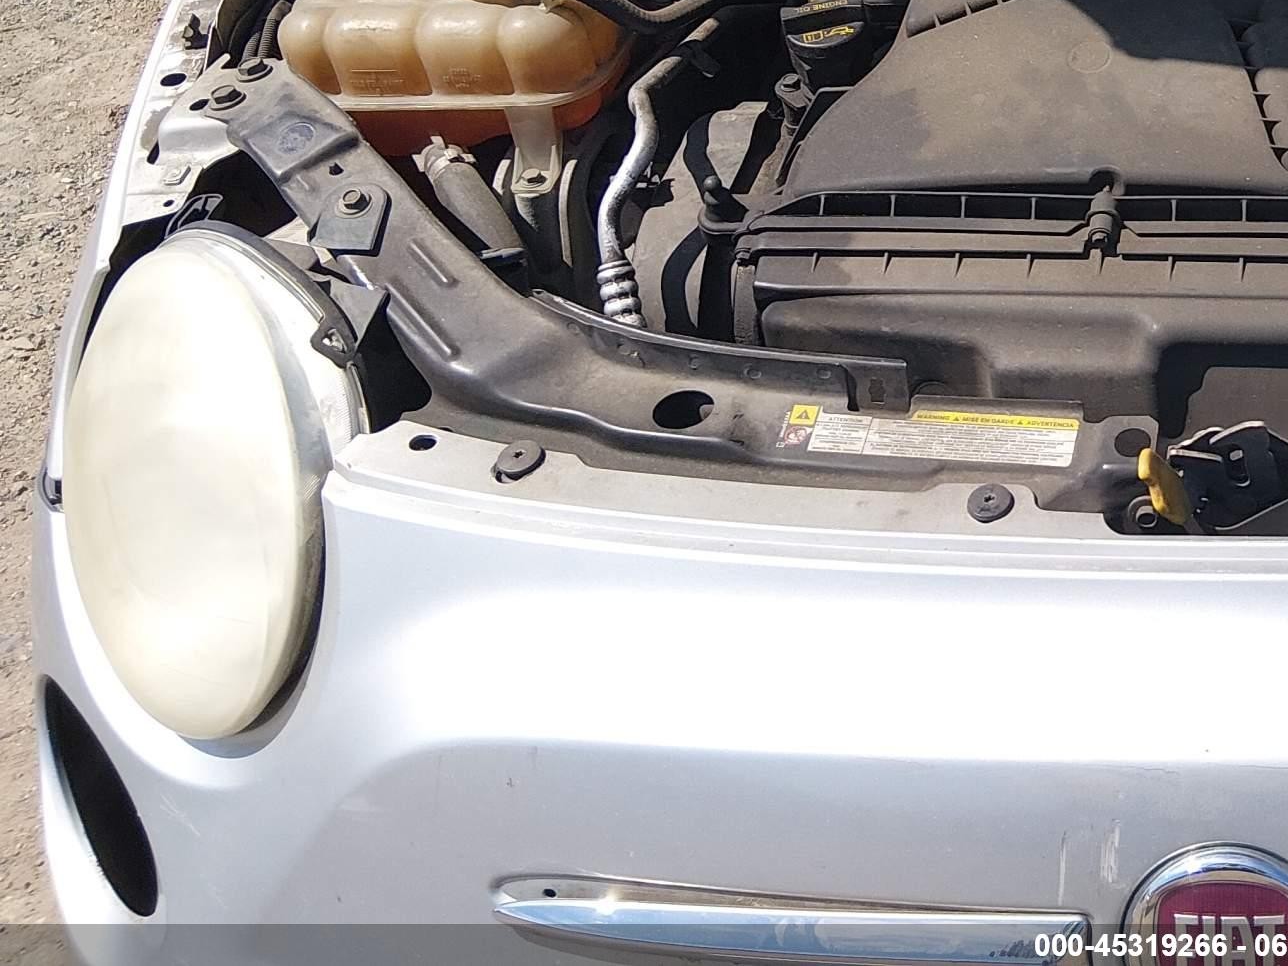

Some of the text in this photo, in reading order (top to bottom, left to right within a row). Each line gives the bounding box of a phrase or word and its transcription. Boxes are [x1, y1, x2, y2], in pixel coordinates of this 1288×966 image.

[795, 5, 811, 14] OIL
[916, 413, 951, 422] WARNING
[961, 416, 979, 424] MISE
[1173, 912, 1286, 966] FIAT
